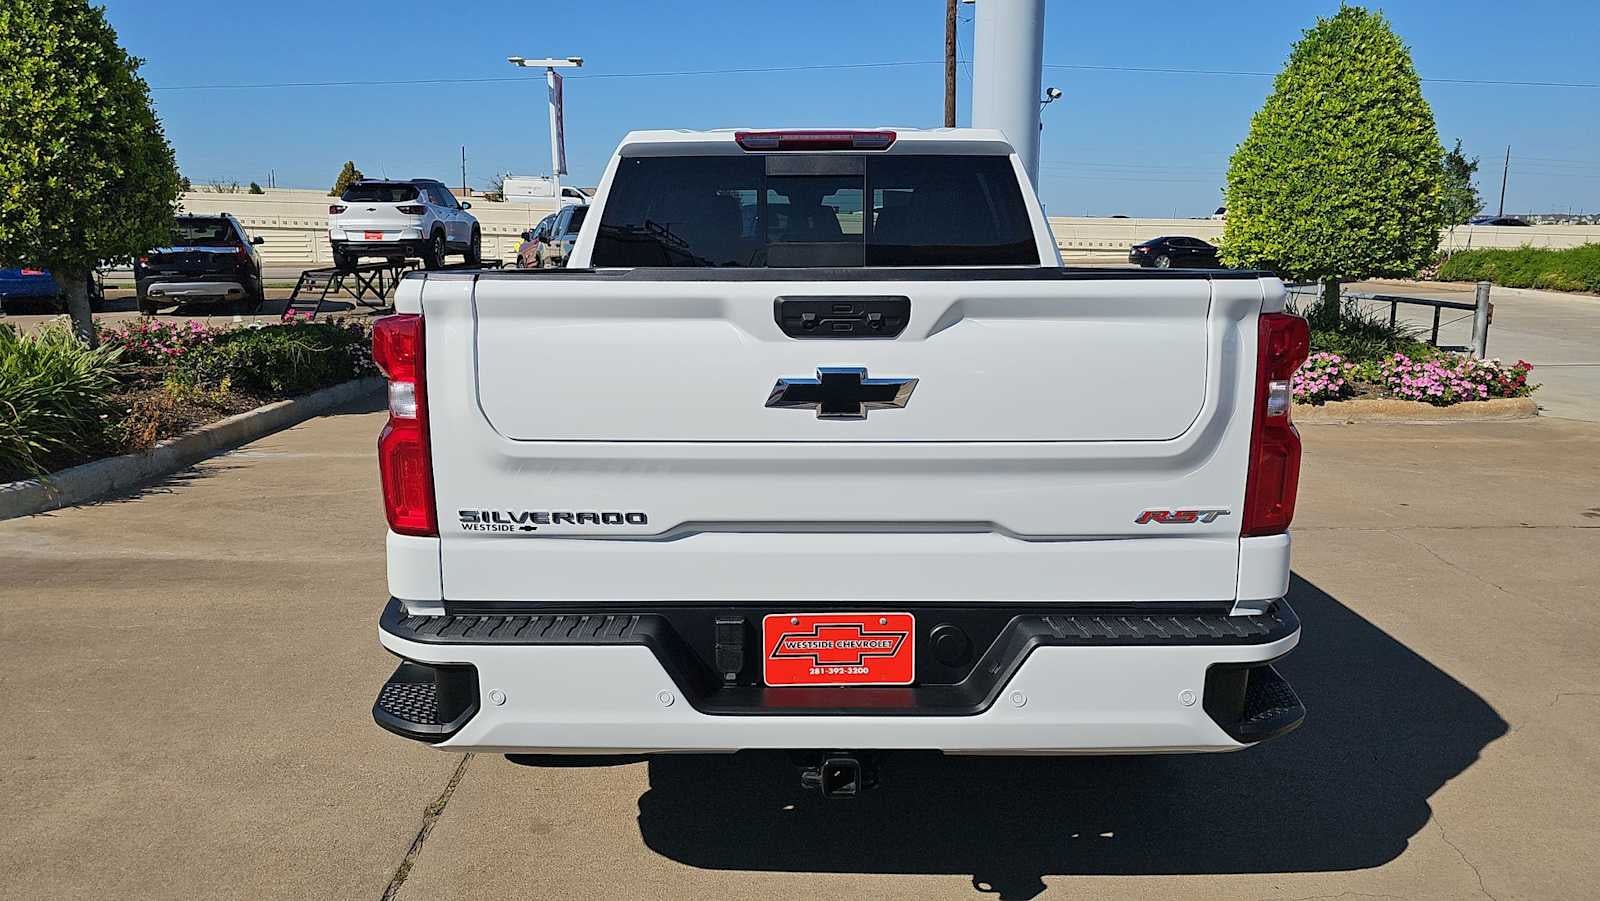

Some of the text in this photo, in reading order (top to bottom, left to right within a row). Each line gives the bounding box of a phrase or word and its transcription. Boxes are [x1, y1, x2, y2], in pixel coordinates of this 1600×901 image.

[459, 510, 648, 525] SILVERADO
[1134, 510, 1231, 524] RST
[462, 523, 515, 532] WESTSIDE
[784, 639, 894, 649] WESTSIDE CHEVROLET
[809, 667, 870, 675] 281-392-3200
